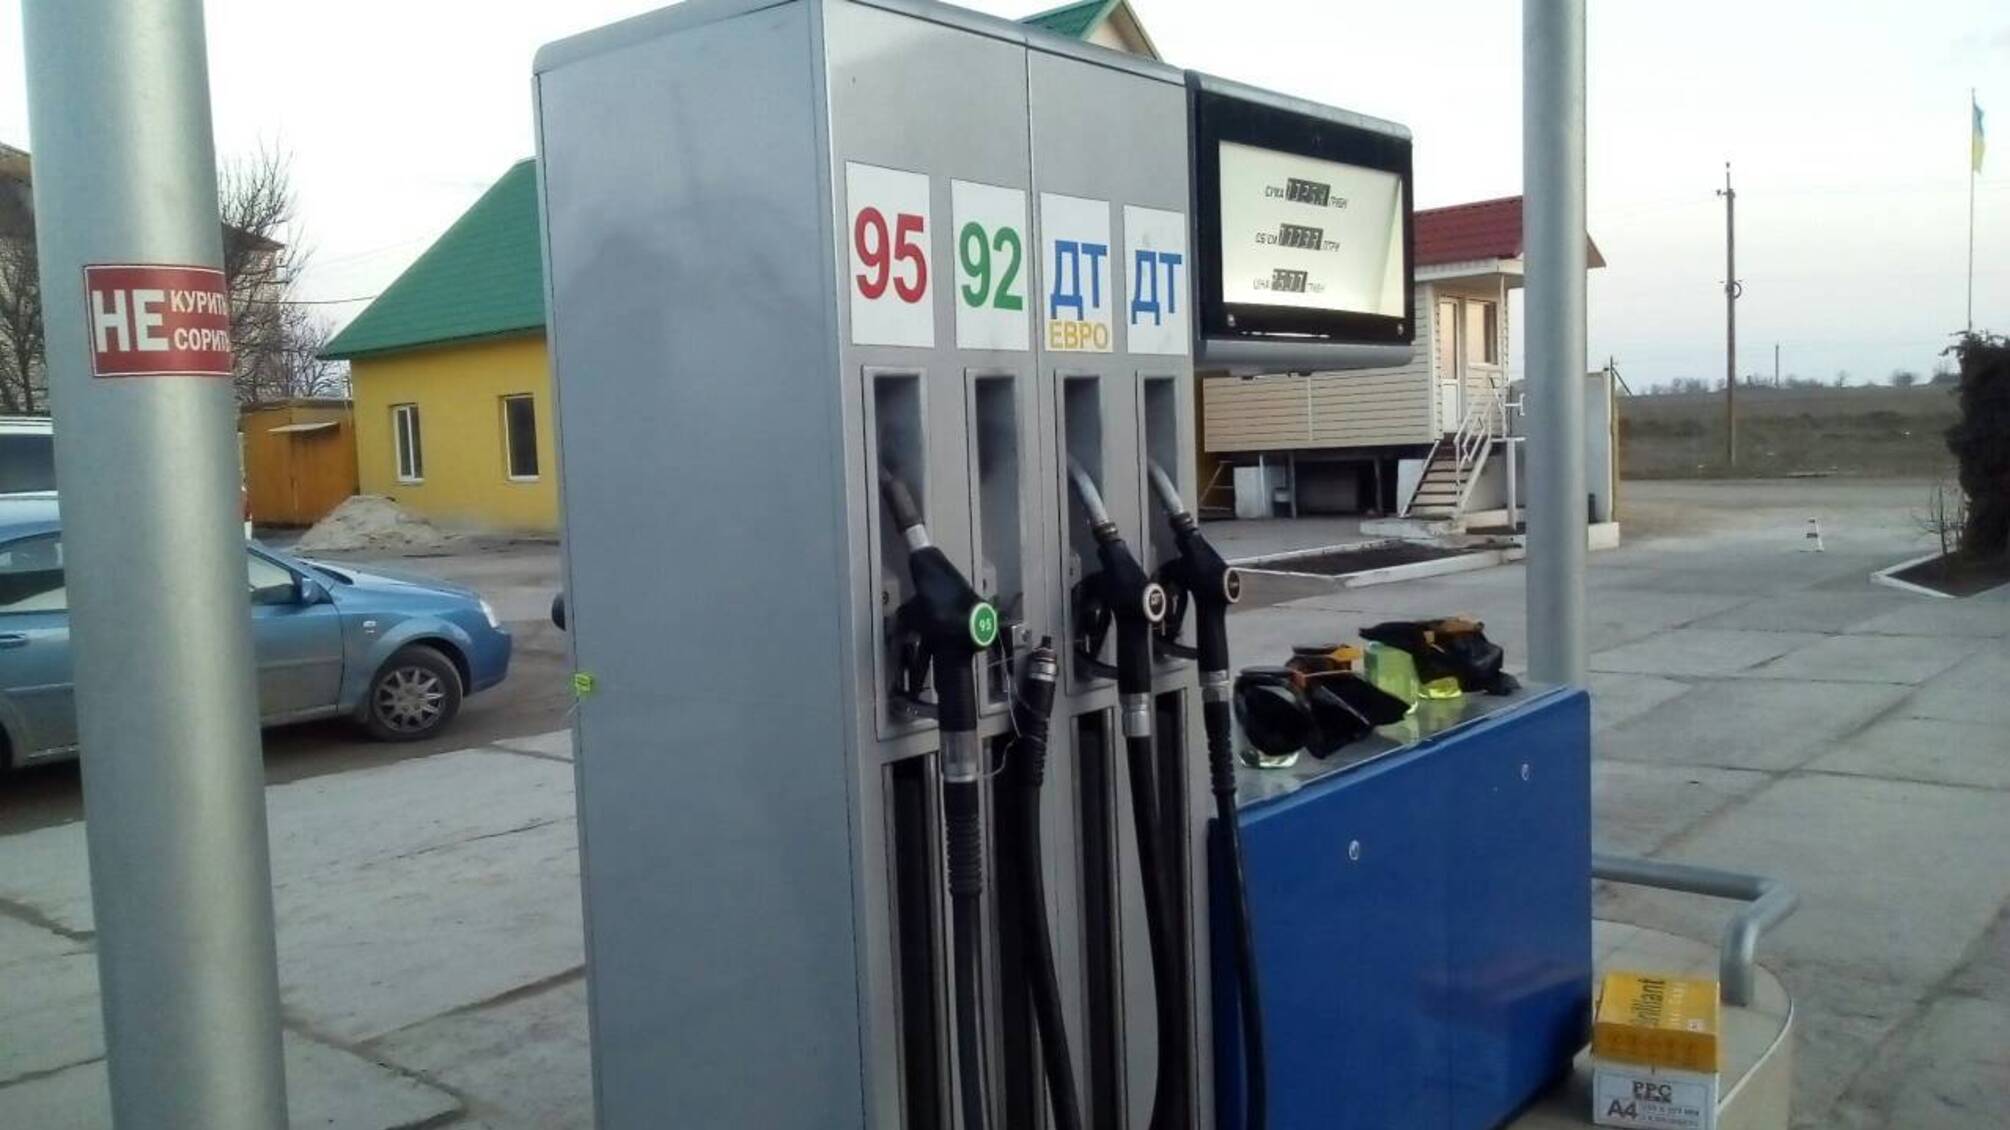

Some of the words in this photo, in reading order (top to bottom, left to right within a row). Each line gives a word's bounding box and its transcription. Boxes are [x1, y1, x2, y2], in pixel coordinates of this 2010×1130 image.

[854, 207, 928, 304] 95
[959, 221, 1024, 311] 92
[1050, 240, 1108, 321] ДТ
[1131, 250, 1182, 326] ДТ
[92, 289, 169, 353] НЕ
[1050, 321, 1109, 350] ЕВРО
[979, 617, 992, 632] 95
[1607, 1099, 1638, 1119] A4
